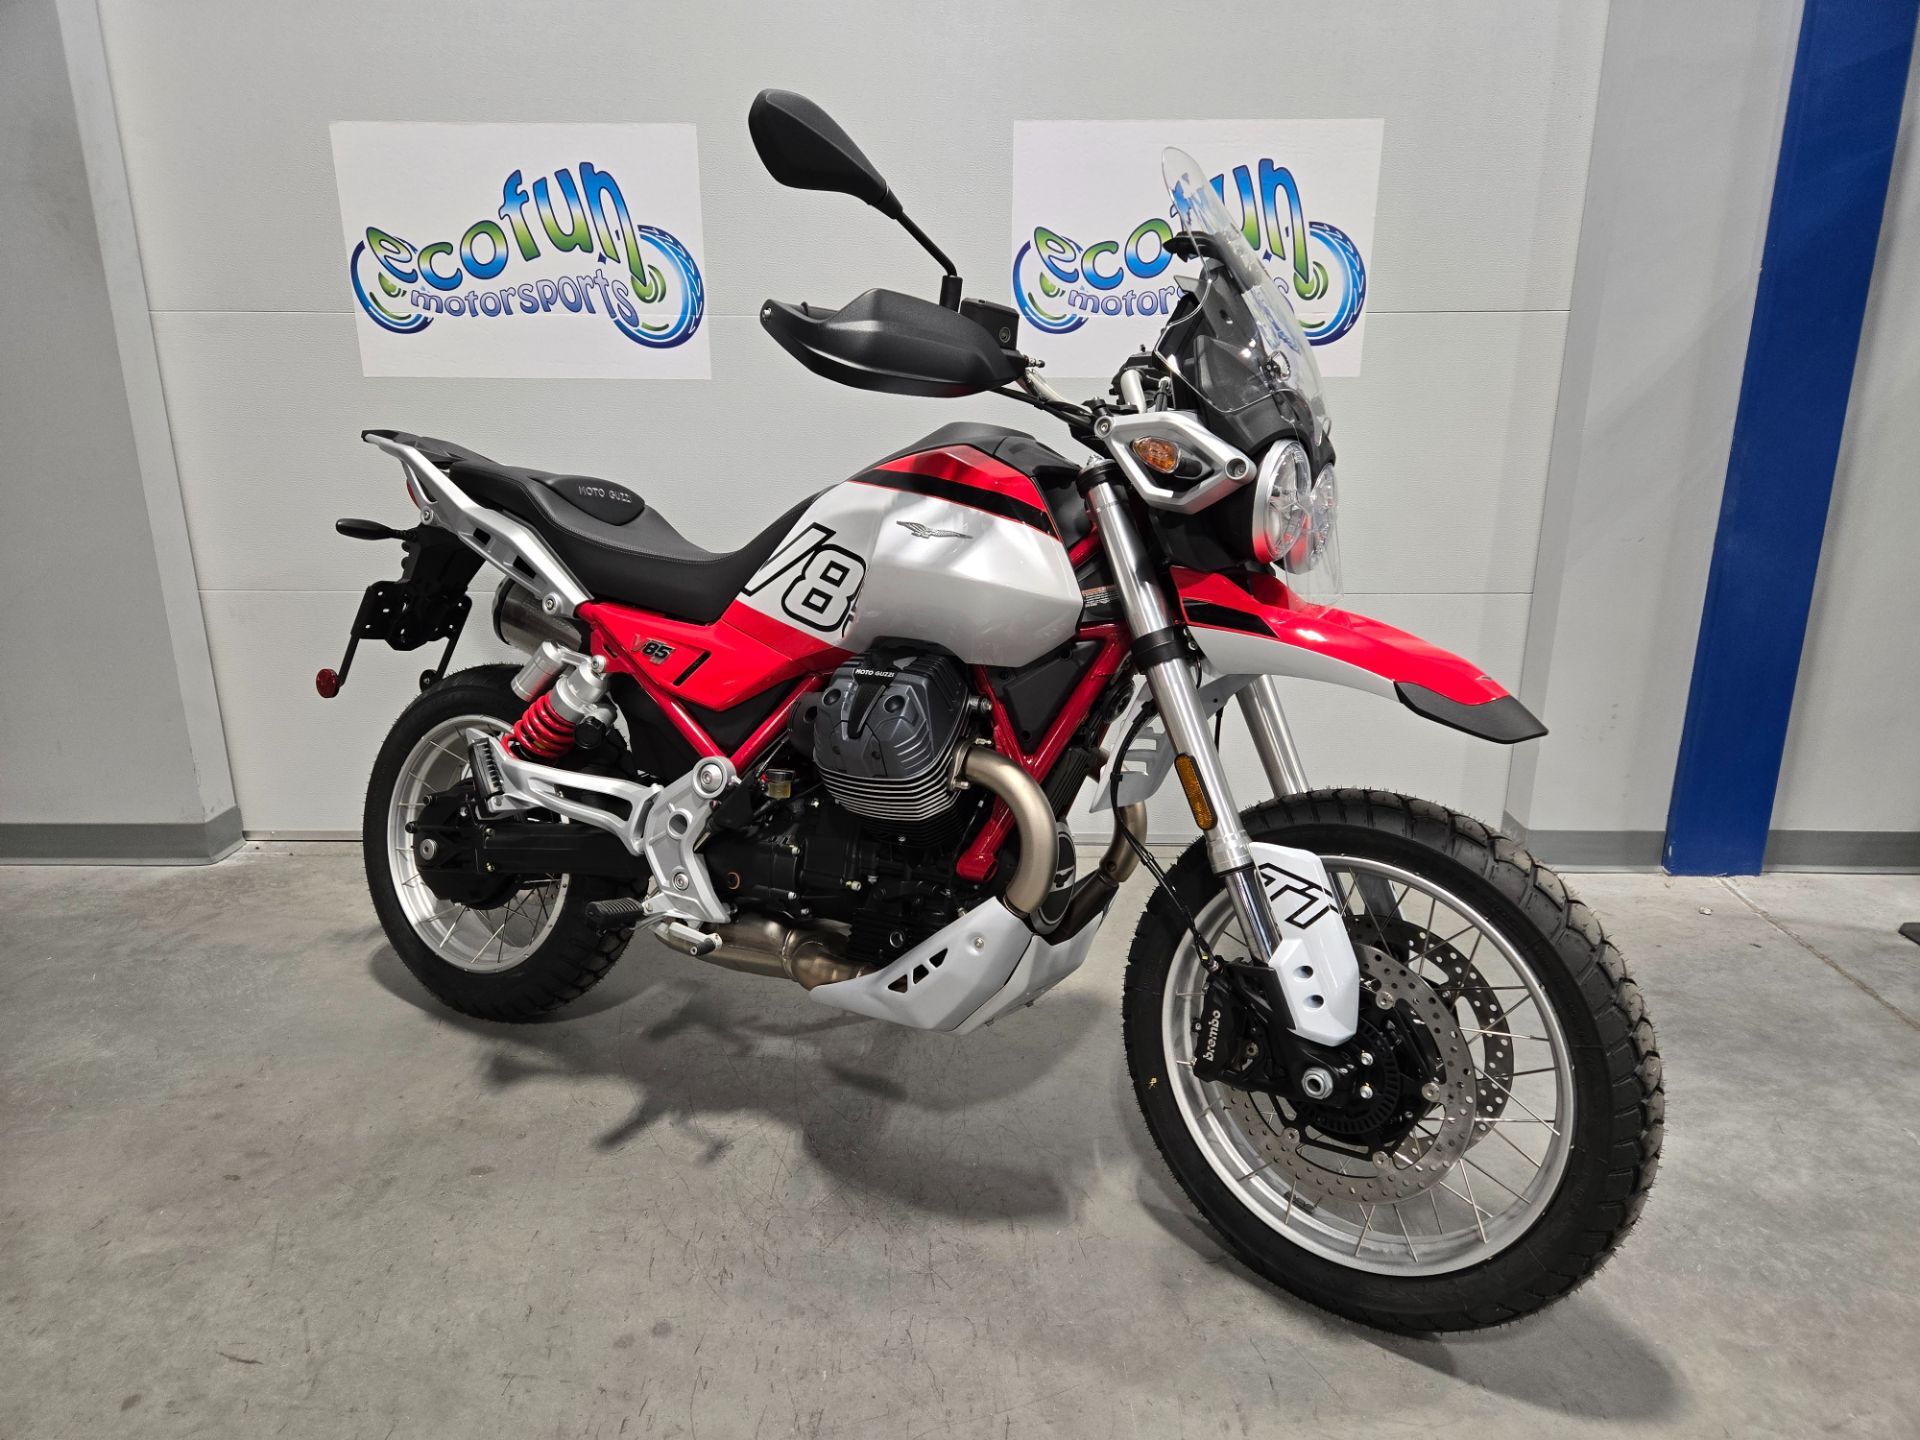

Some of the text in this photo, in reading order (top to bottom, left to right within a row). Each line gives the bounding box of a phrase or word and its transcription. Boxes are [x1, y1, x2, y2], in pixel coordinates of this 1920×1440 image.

[366, 162, 647, 291] ecofun
[410, 268, 640, 328] motorsports
[578, 486, 605, 498] MOTO
[1202, 1009, 1222, 1062] brembo
